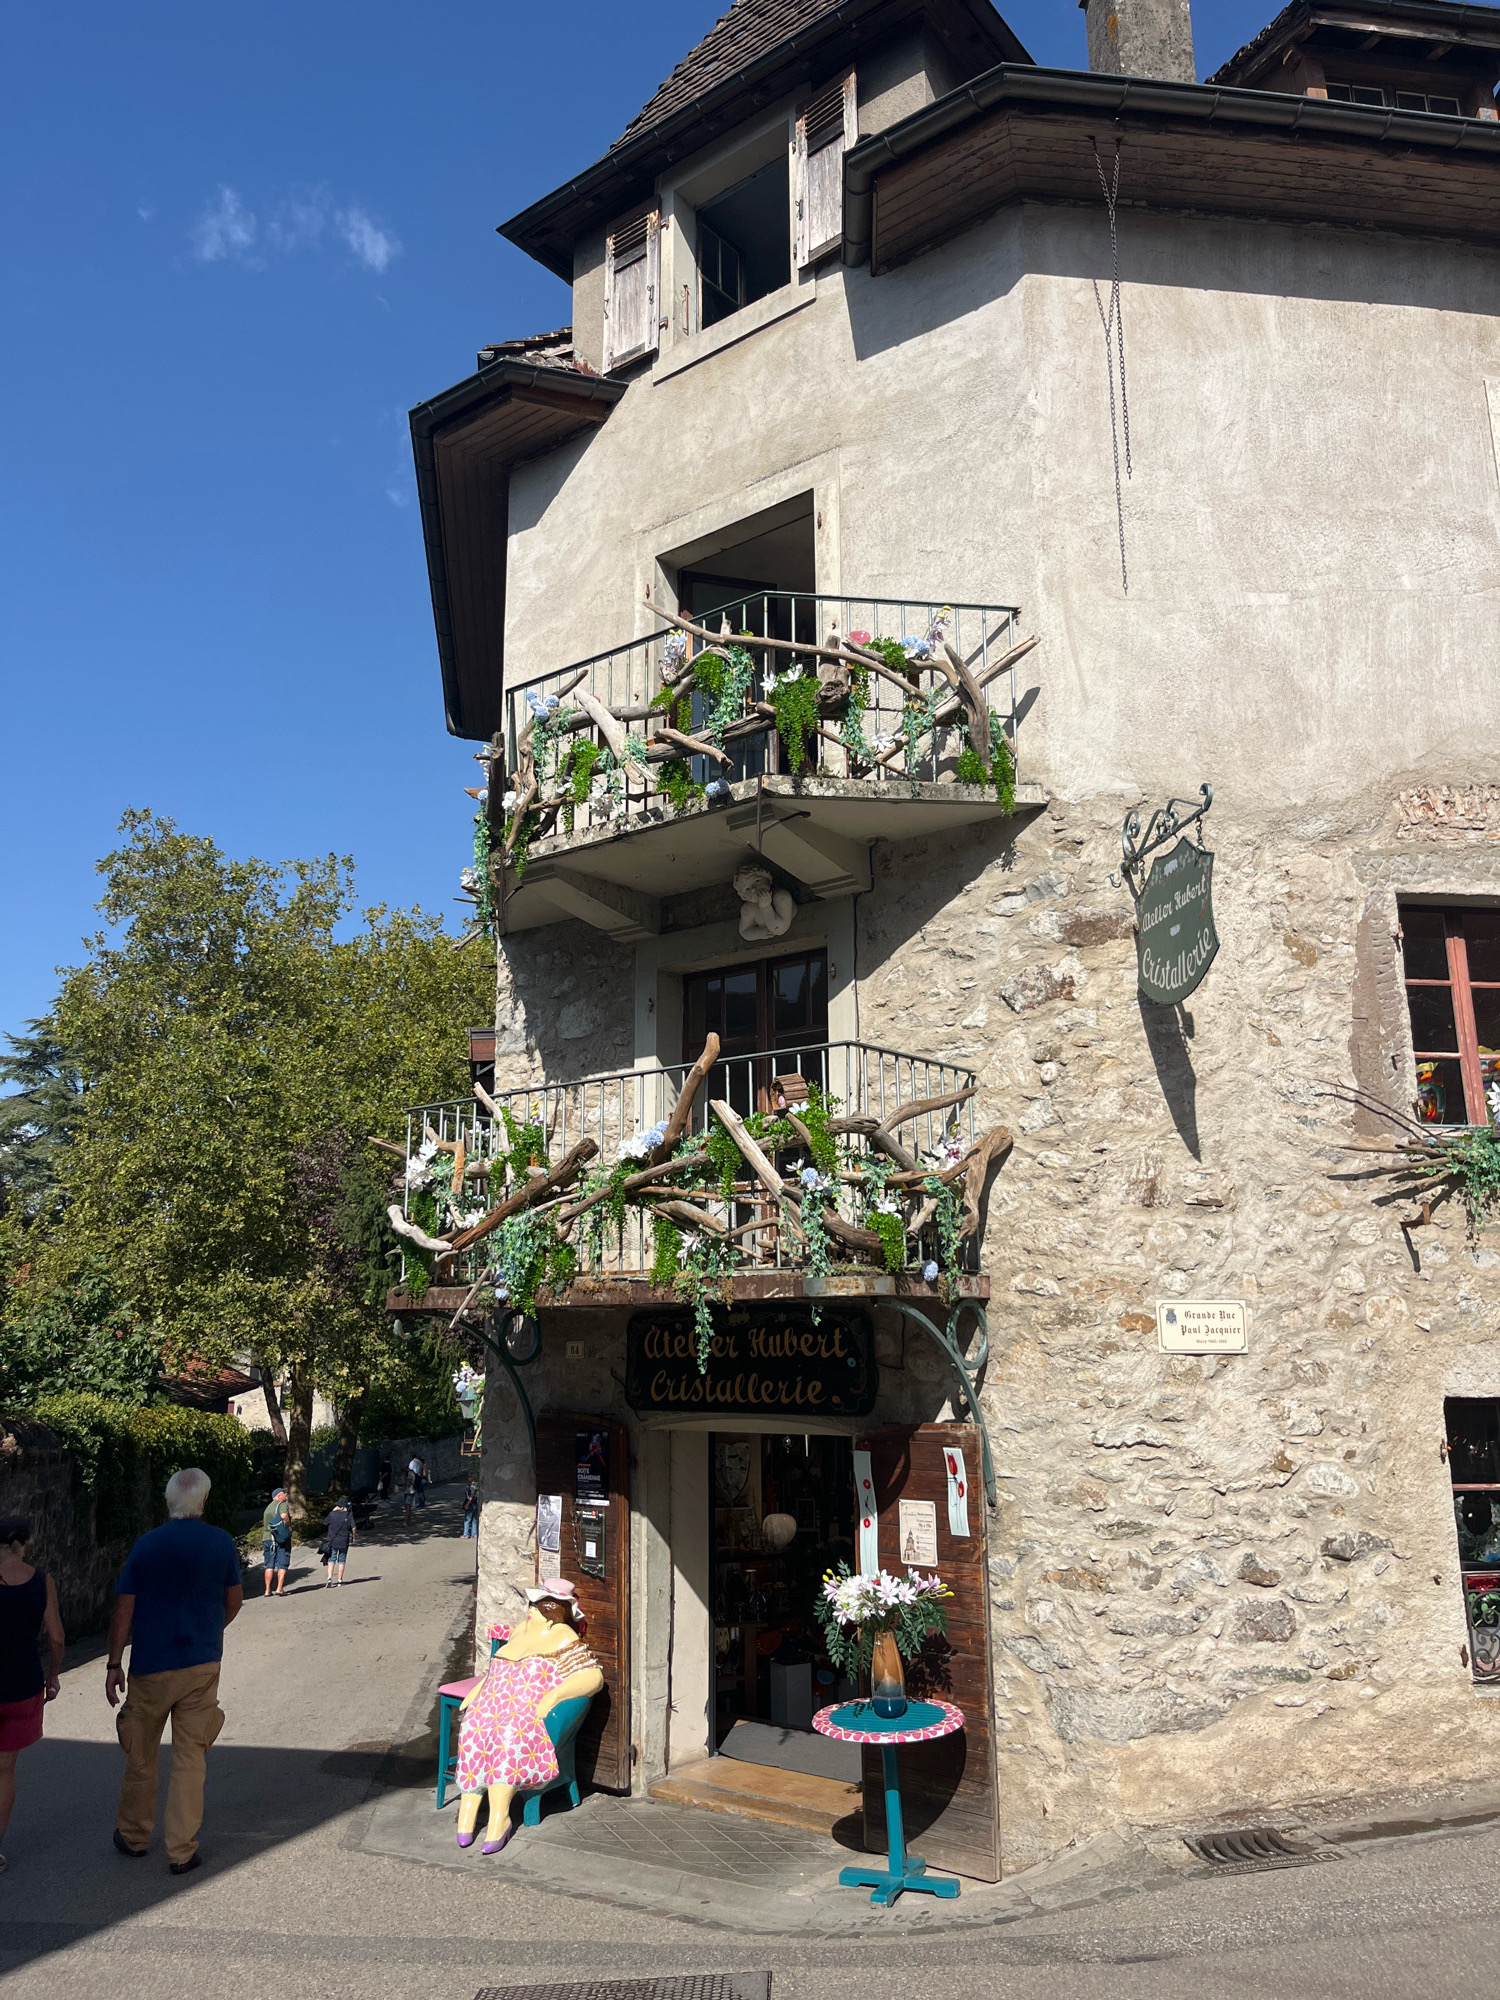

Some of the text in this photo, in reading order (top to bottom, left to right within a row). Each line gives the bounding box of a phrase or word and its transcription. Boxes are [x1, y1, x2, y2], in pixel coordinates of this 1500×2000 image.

[1142, 874, 1206, 932] Atelier Hubert
[1142, 927, 1213, 990] Cristallerie
[1180, 1324, 1241, 1336] Paul Jacquier
[1184, 1310, 1236, 1321] Grande Rue
[644, 1327, 847, 1358] Ateler Hubert
[650, 1369, 827, 1404] Cristallerie
[1269, 1858, 1314, 1867] COMMENCE
[1312, 1852, 1340, 1862] ICI
